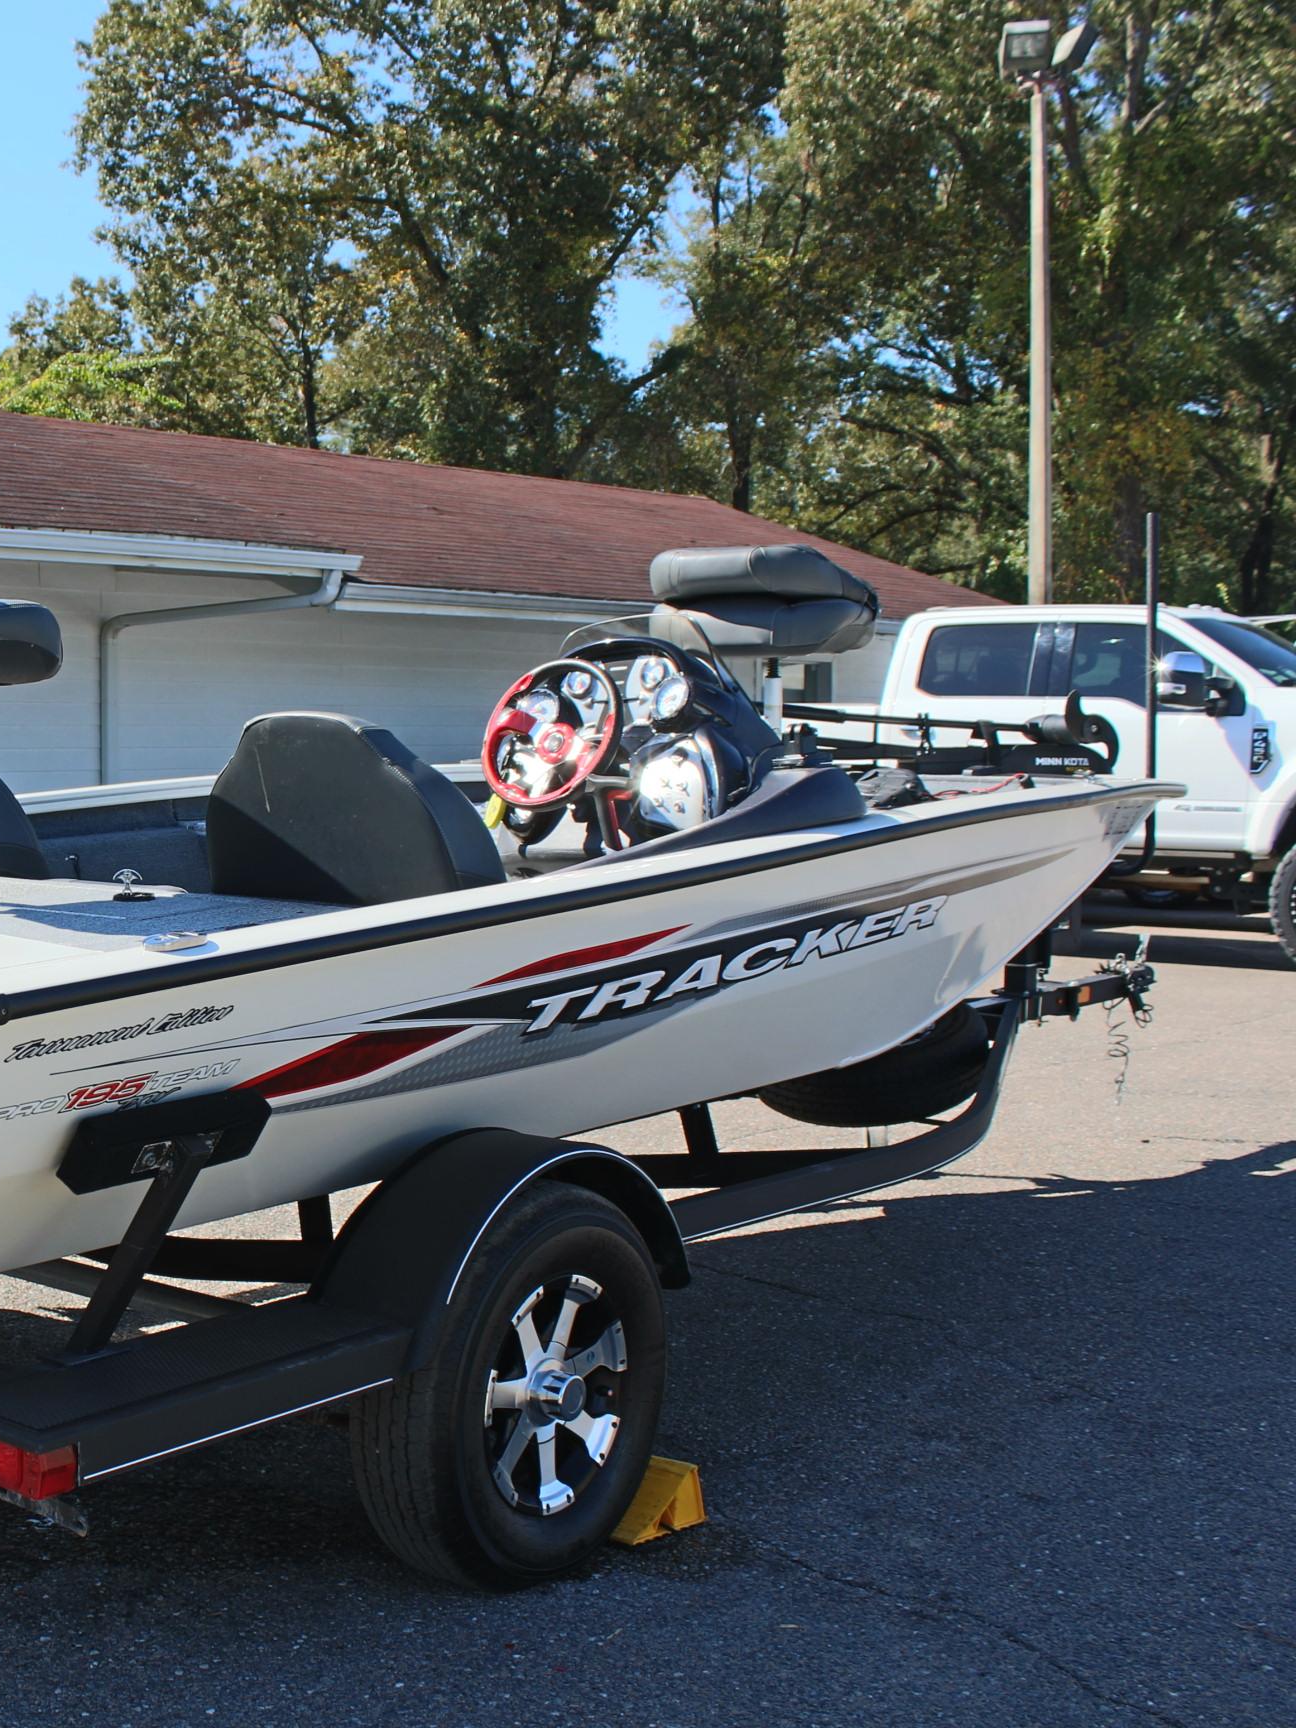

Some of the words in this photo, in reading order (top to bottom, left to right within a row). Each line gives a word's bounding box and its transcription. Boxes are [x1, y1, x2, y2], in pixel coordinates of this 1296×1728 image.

[1035, 757, 1062, 766] MINN
[1064, 757, 1089, 766] KOTA
[524, 895, 950, 1036] TRACKER
[4, 1018, 155, 1063] Tournament
[146, 1005, 234, 1035] Edition
[59, 1072, 158, 1113] 195
[150, 1059, 241, 1091] TEAM
